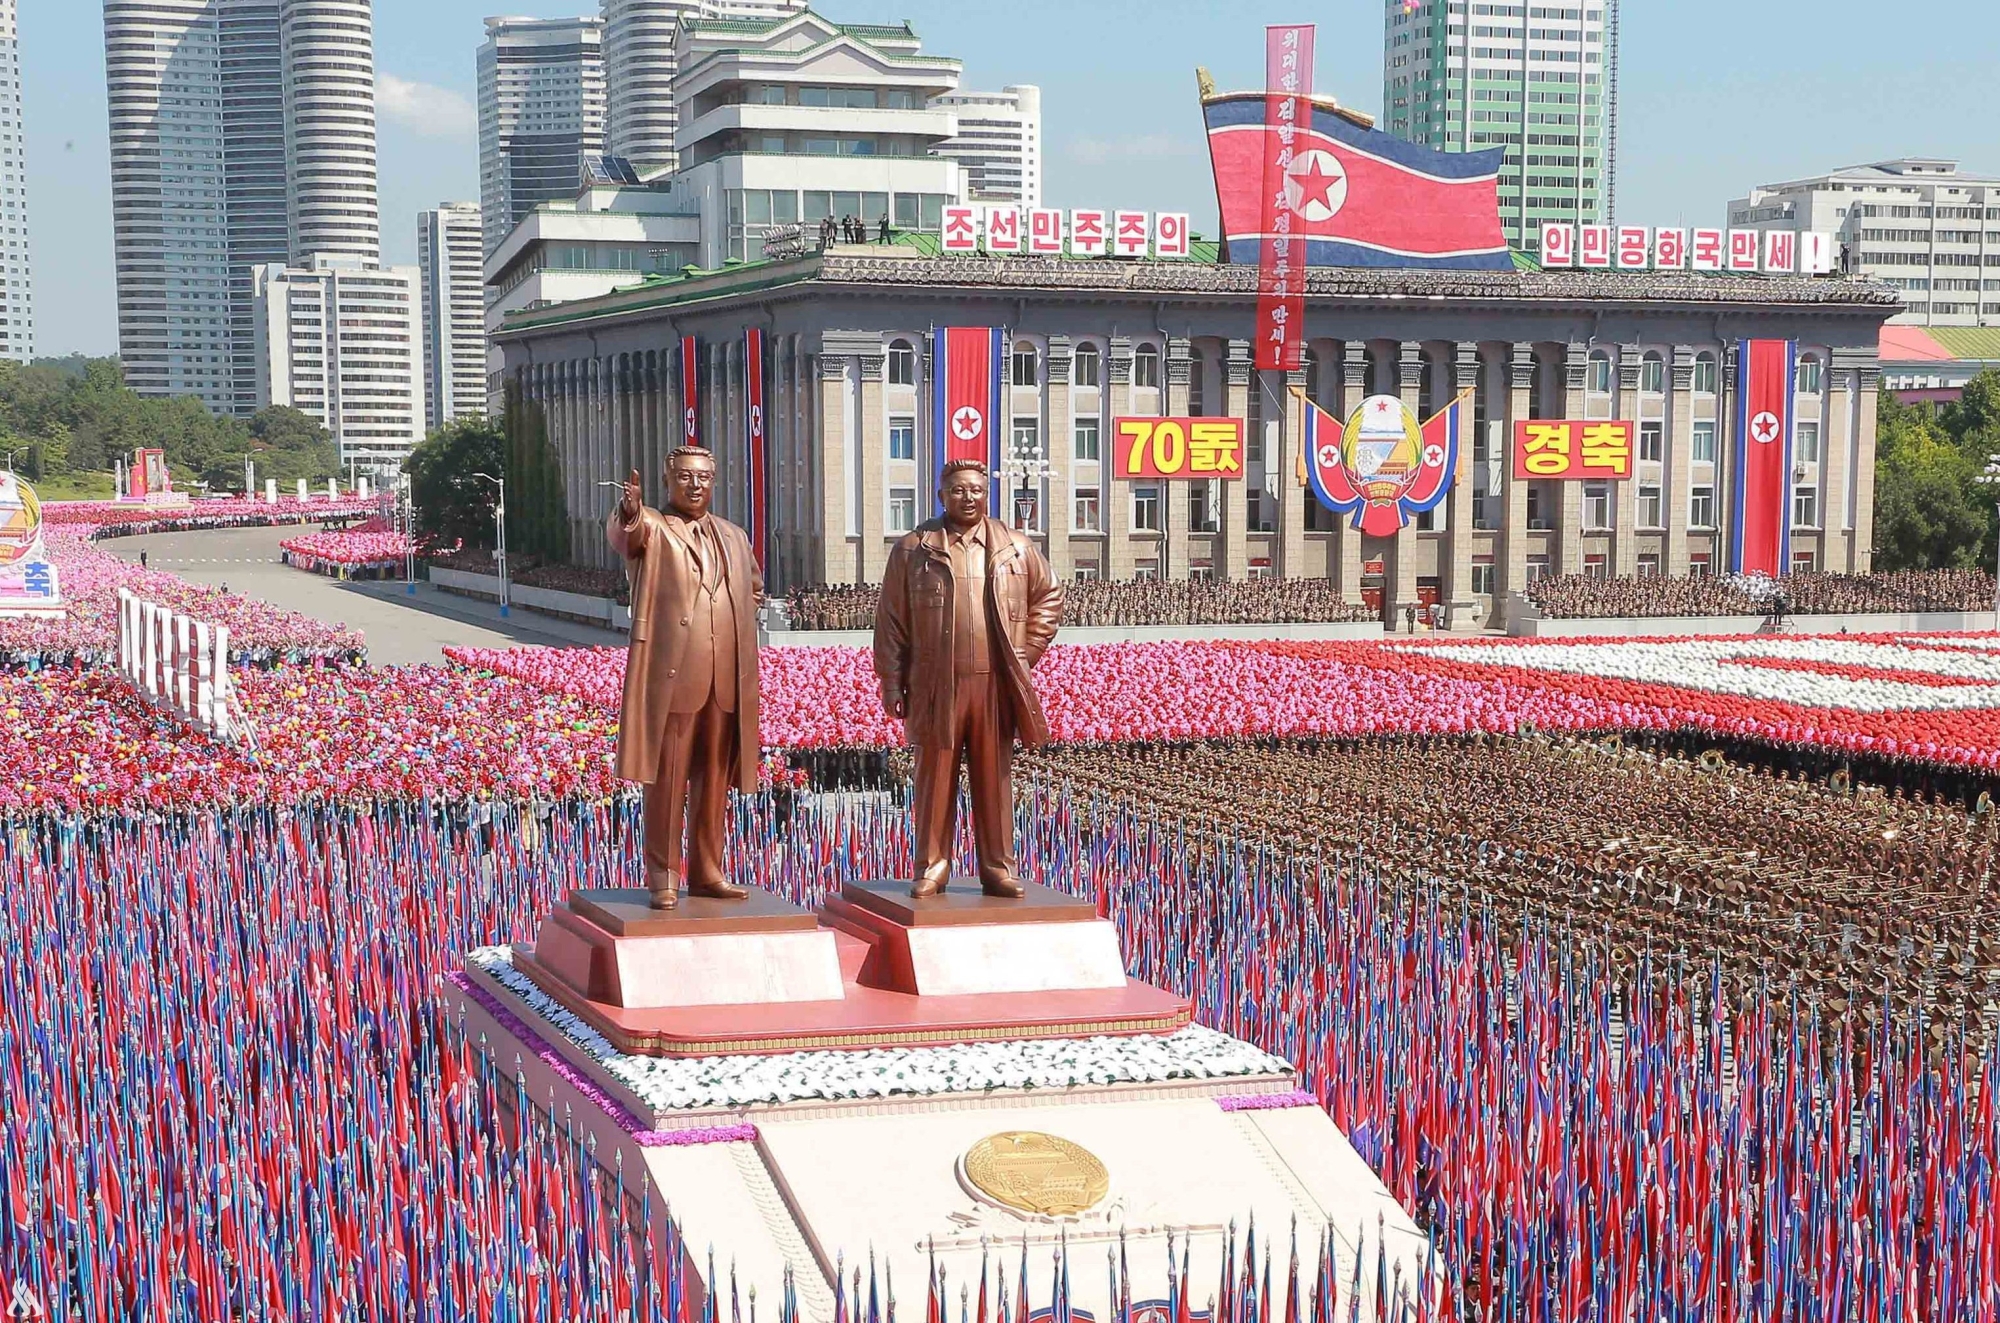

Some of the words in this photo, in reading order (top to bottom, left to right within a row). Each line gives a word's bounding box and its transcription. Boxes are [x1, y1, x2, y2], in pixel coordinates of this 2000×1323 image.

[1281, 28, 1300, 92] 위대한
[946, 209, 1186, 254] 조선민주주의
[1269, 304, 1290, 366] 만세!
[1119, 421, 1240, 475] 70돐
[1523, 422, 1630, 475] 경축
